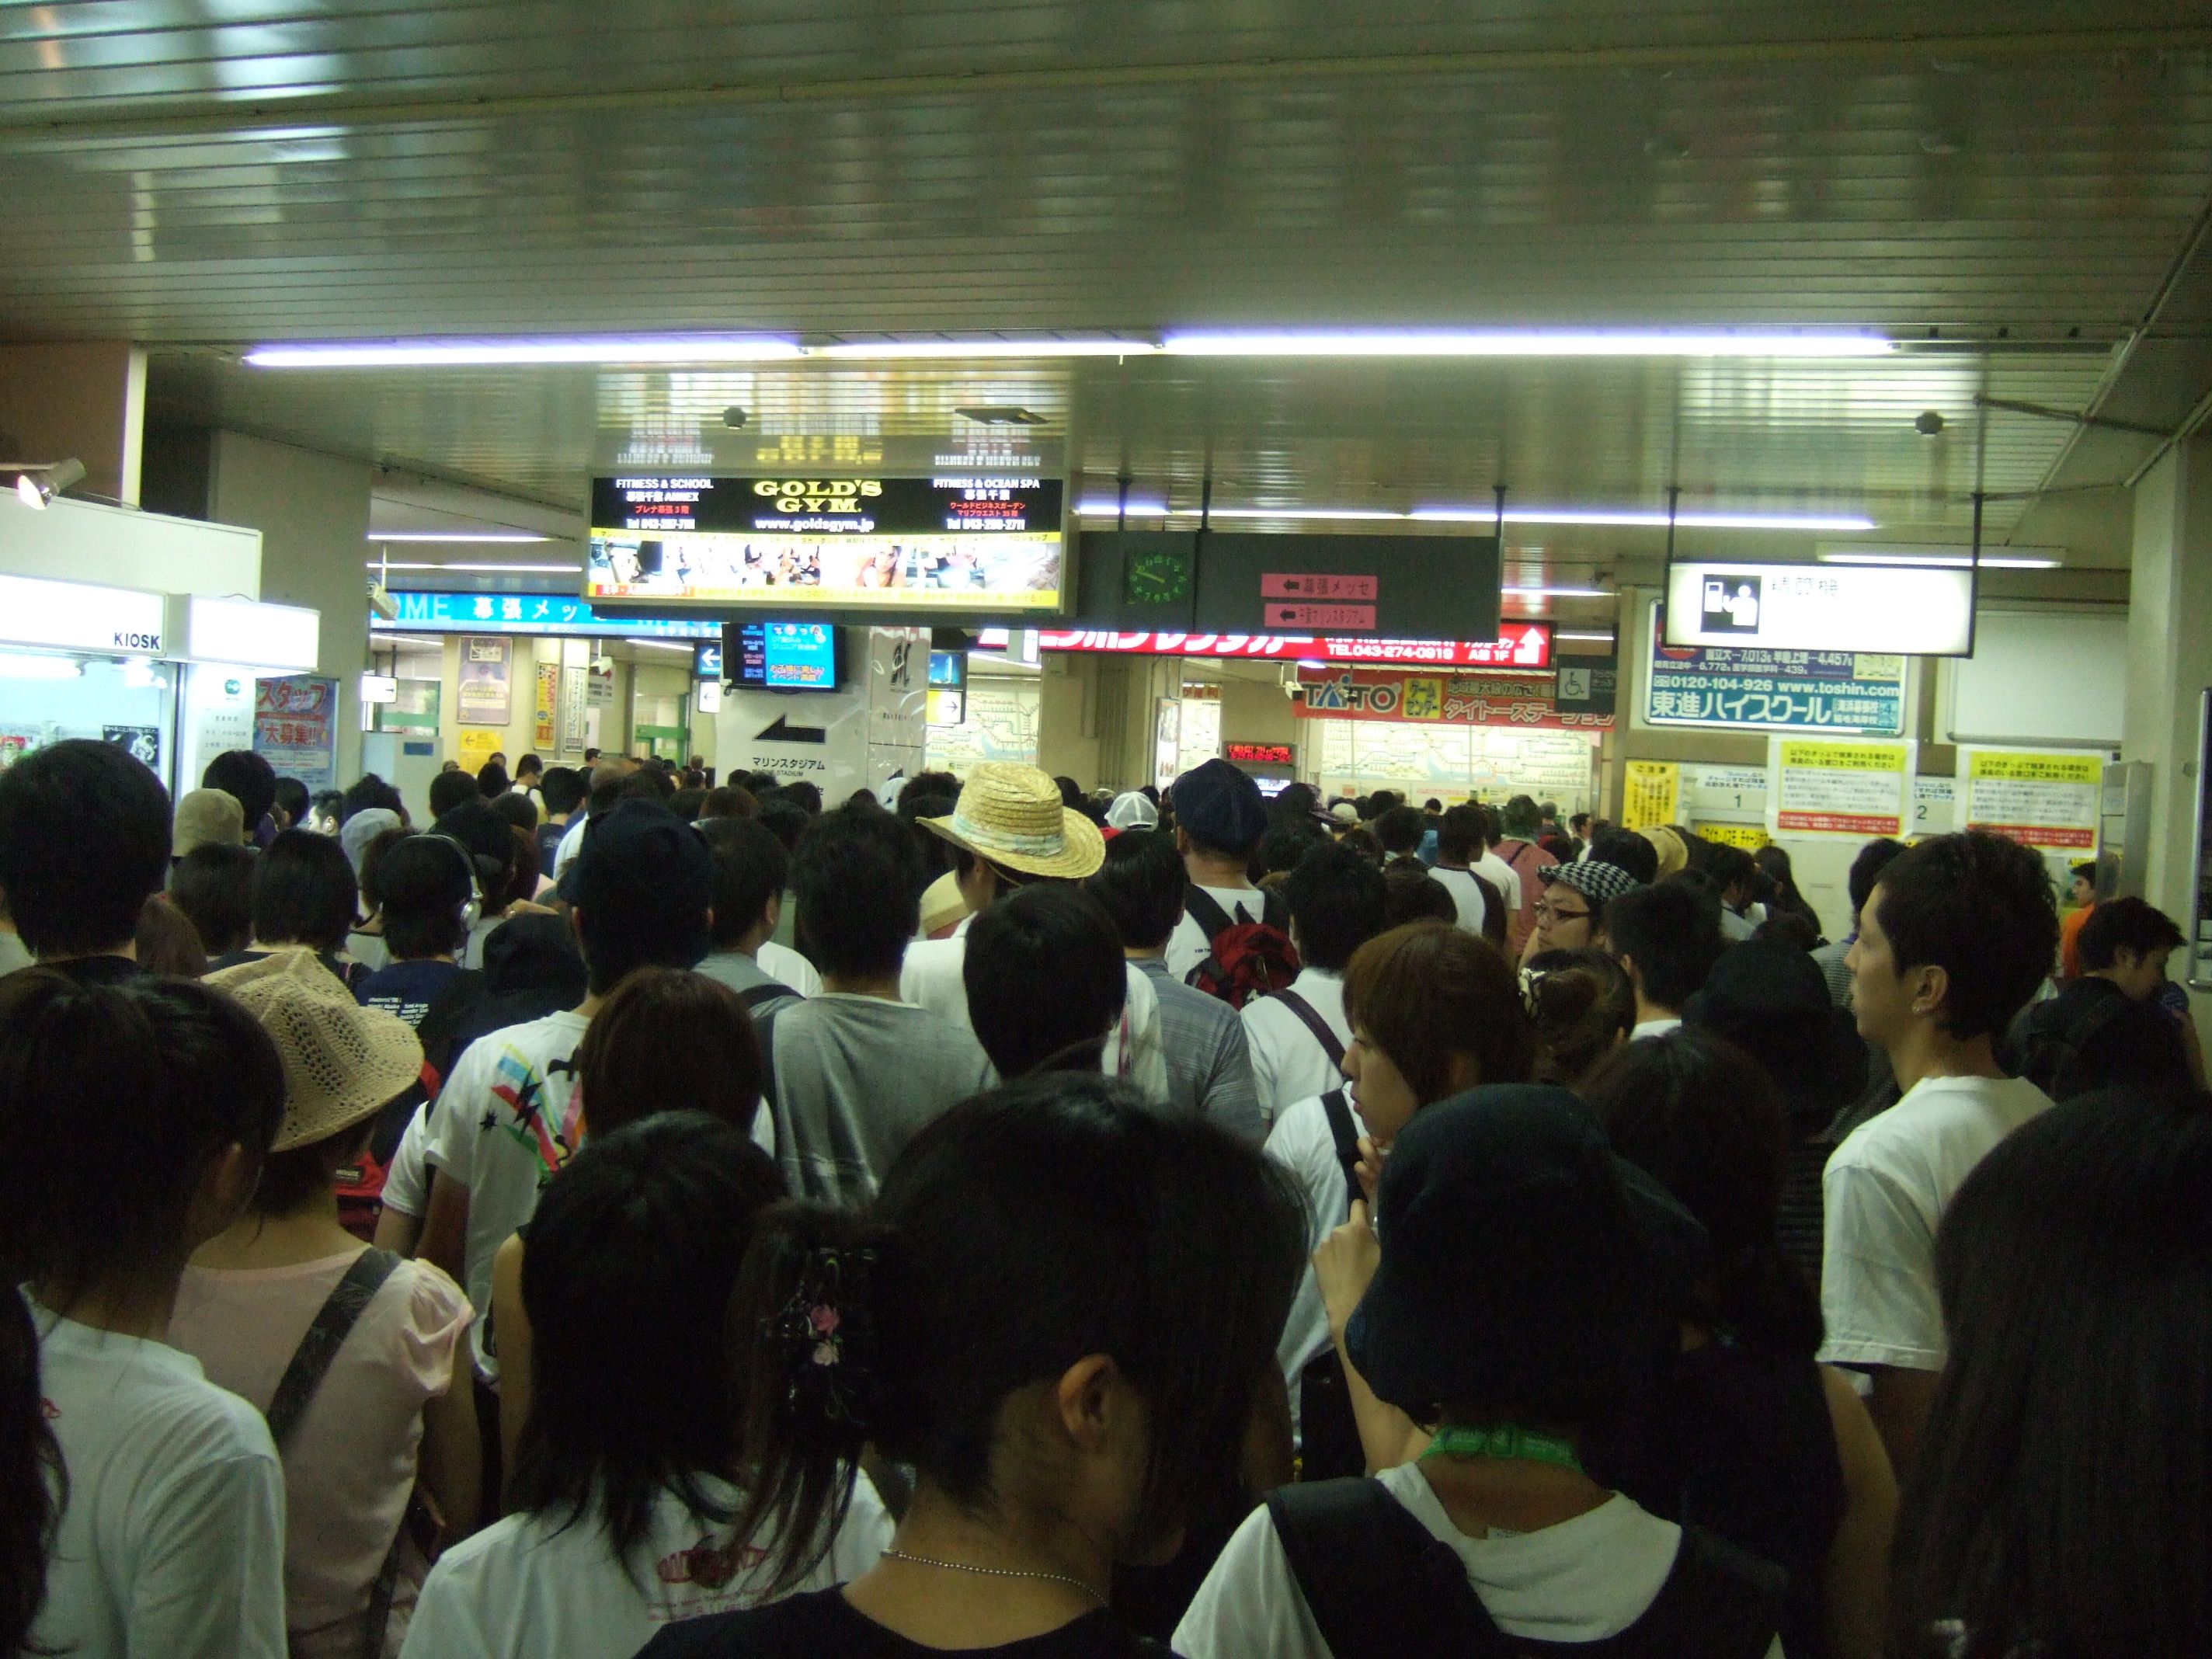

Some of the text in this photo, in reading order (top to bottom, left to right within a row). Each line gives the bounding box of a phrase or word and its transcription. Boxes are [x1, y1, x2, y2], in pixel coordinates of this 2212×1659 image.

[616, 478, 714, 489] FITNESS & SCHOOL
[754, 479, 882, 497] GOLD'S
[934, 478, 1041, 489] FITNESS & OCEAN SPA
[755, 518, 875, 532] www.goldsgym.jp
[473, 596, 579, 622] 幕張メッ
[114, 632, 160, 650] KIOSK
[1671, 676, 1900, 697] 0120-104-926 www.toshin.com
[258, 680, 327, 711] スタッフ
[1651, 690, 1832, 724] 東進ハイスクール
[753, 756, 825, 770] マリンスタジアム
[1734, 795, 1741, 808] 1
[1917, 805, 1927, 819] 2
